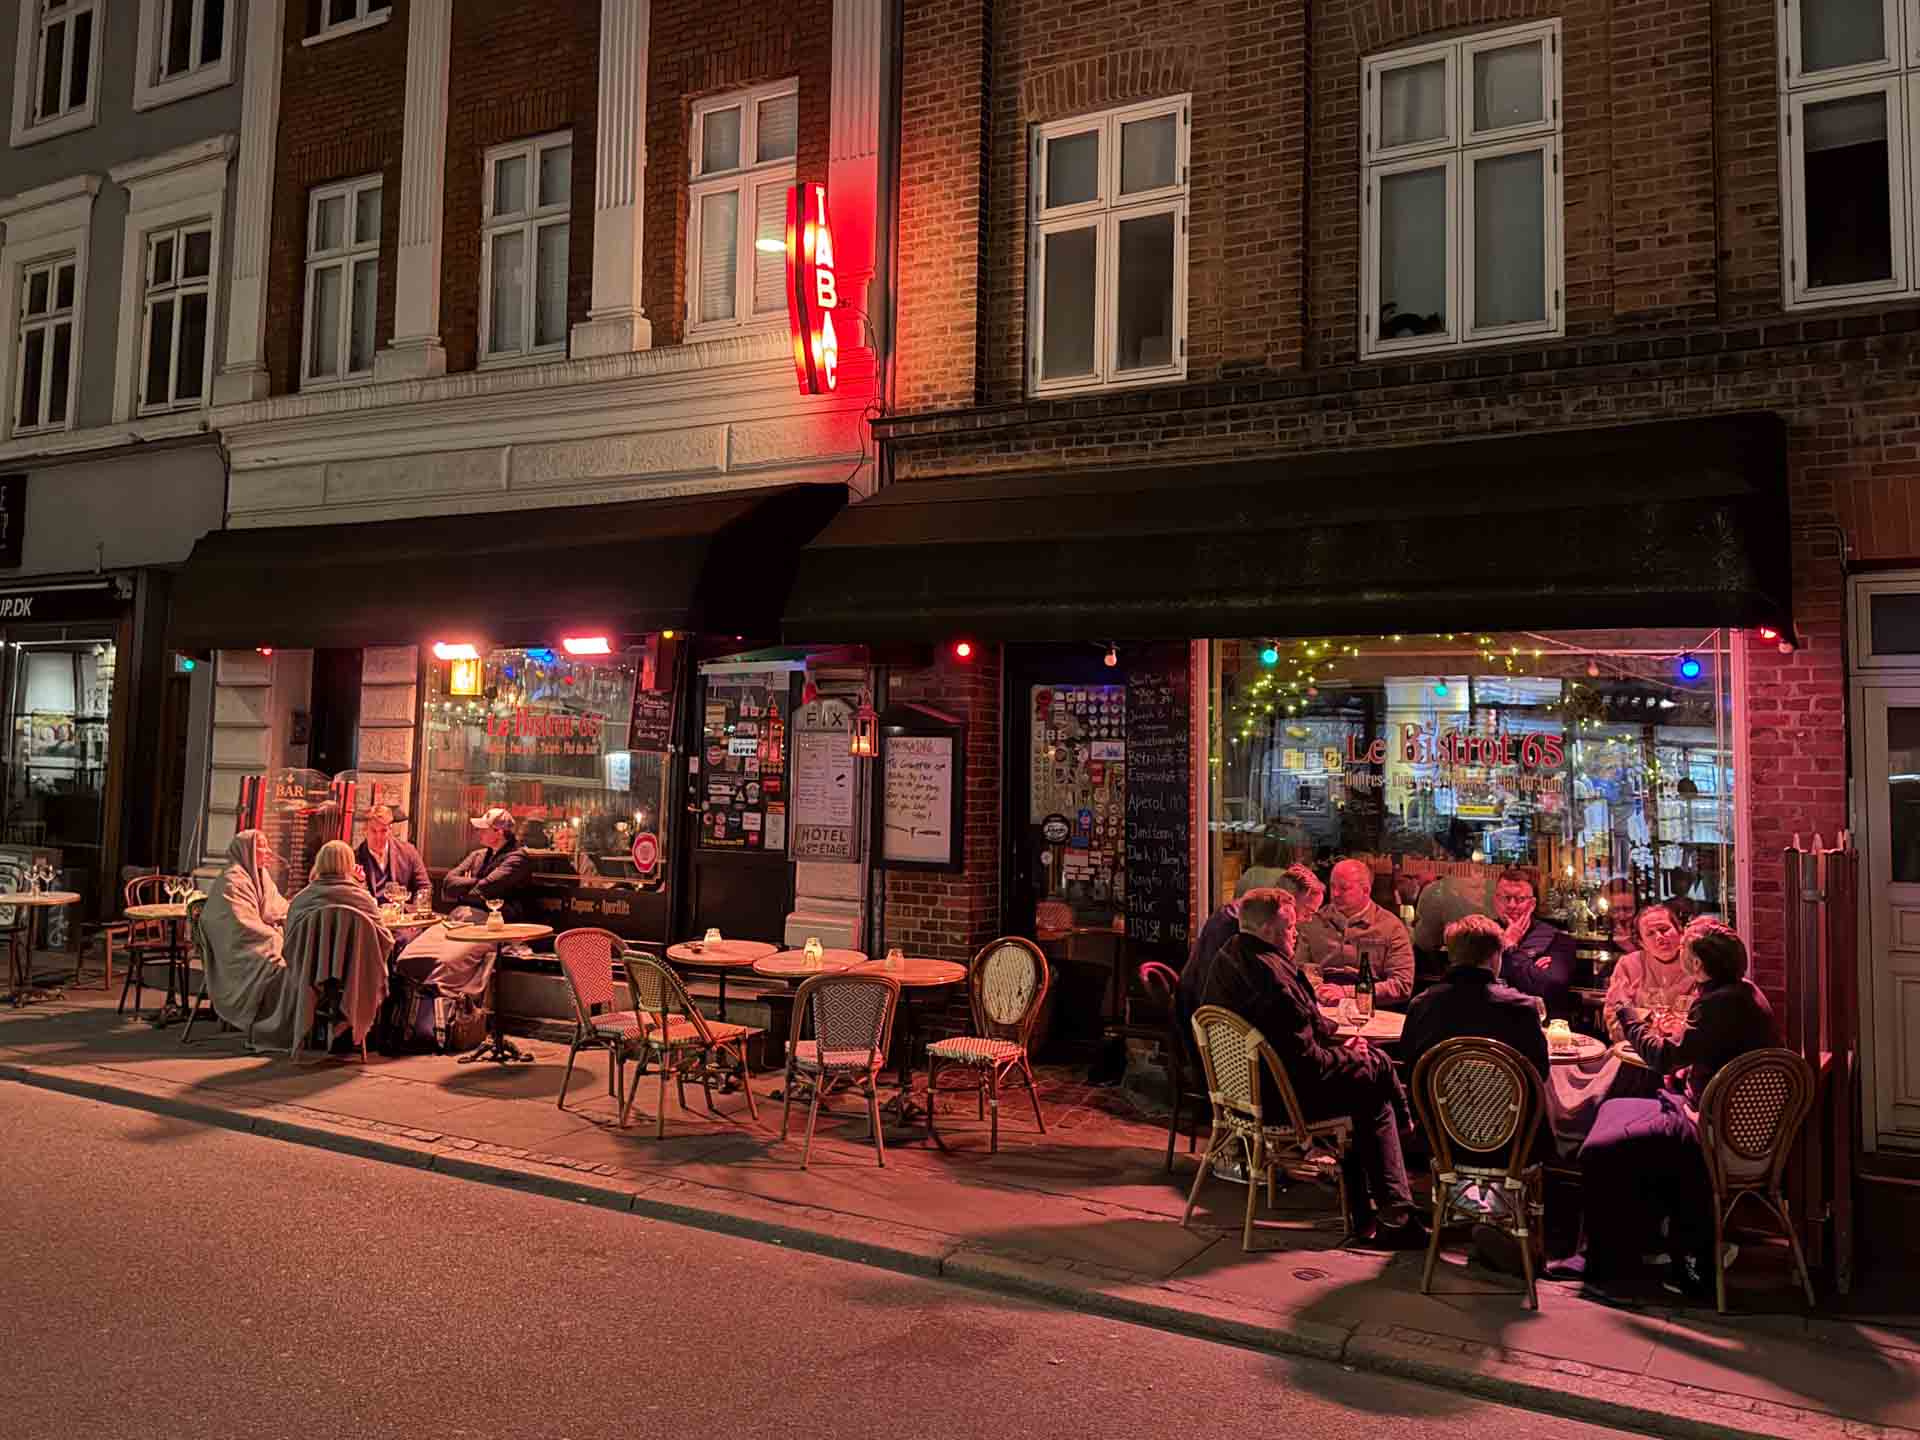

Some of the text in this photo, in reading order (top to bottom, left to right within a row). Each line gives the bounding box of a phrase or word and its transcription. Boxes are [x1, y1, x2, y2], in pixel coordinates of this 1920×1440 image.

[815, 186, 838, 391] TABAC
[487, 711, 510, 737] Le
[578, 710, 605, 737] 65
[1344, 721, 1565, 769] Le Bistrot 65
[275, 783, 304, 798] BAR
